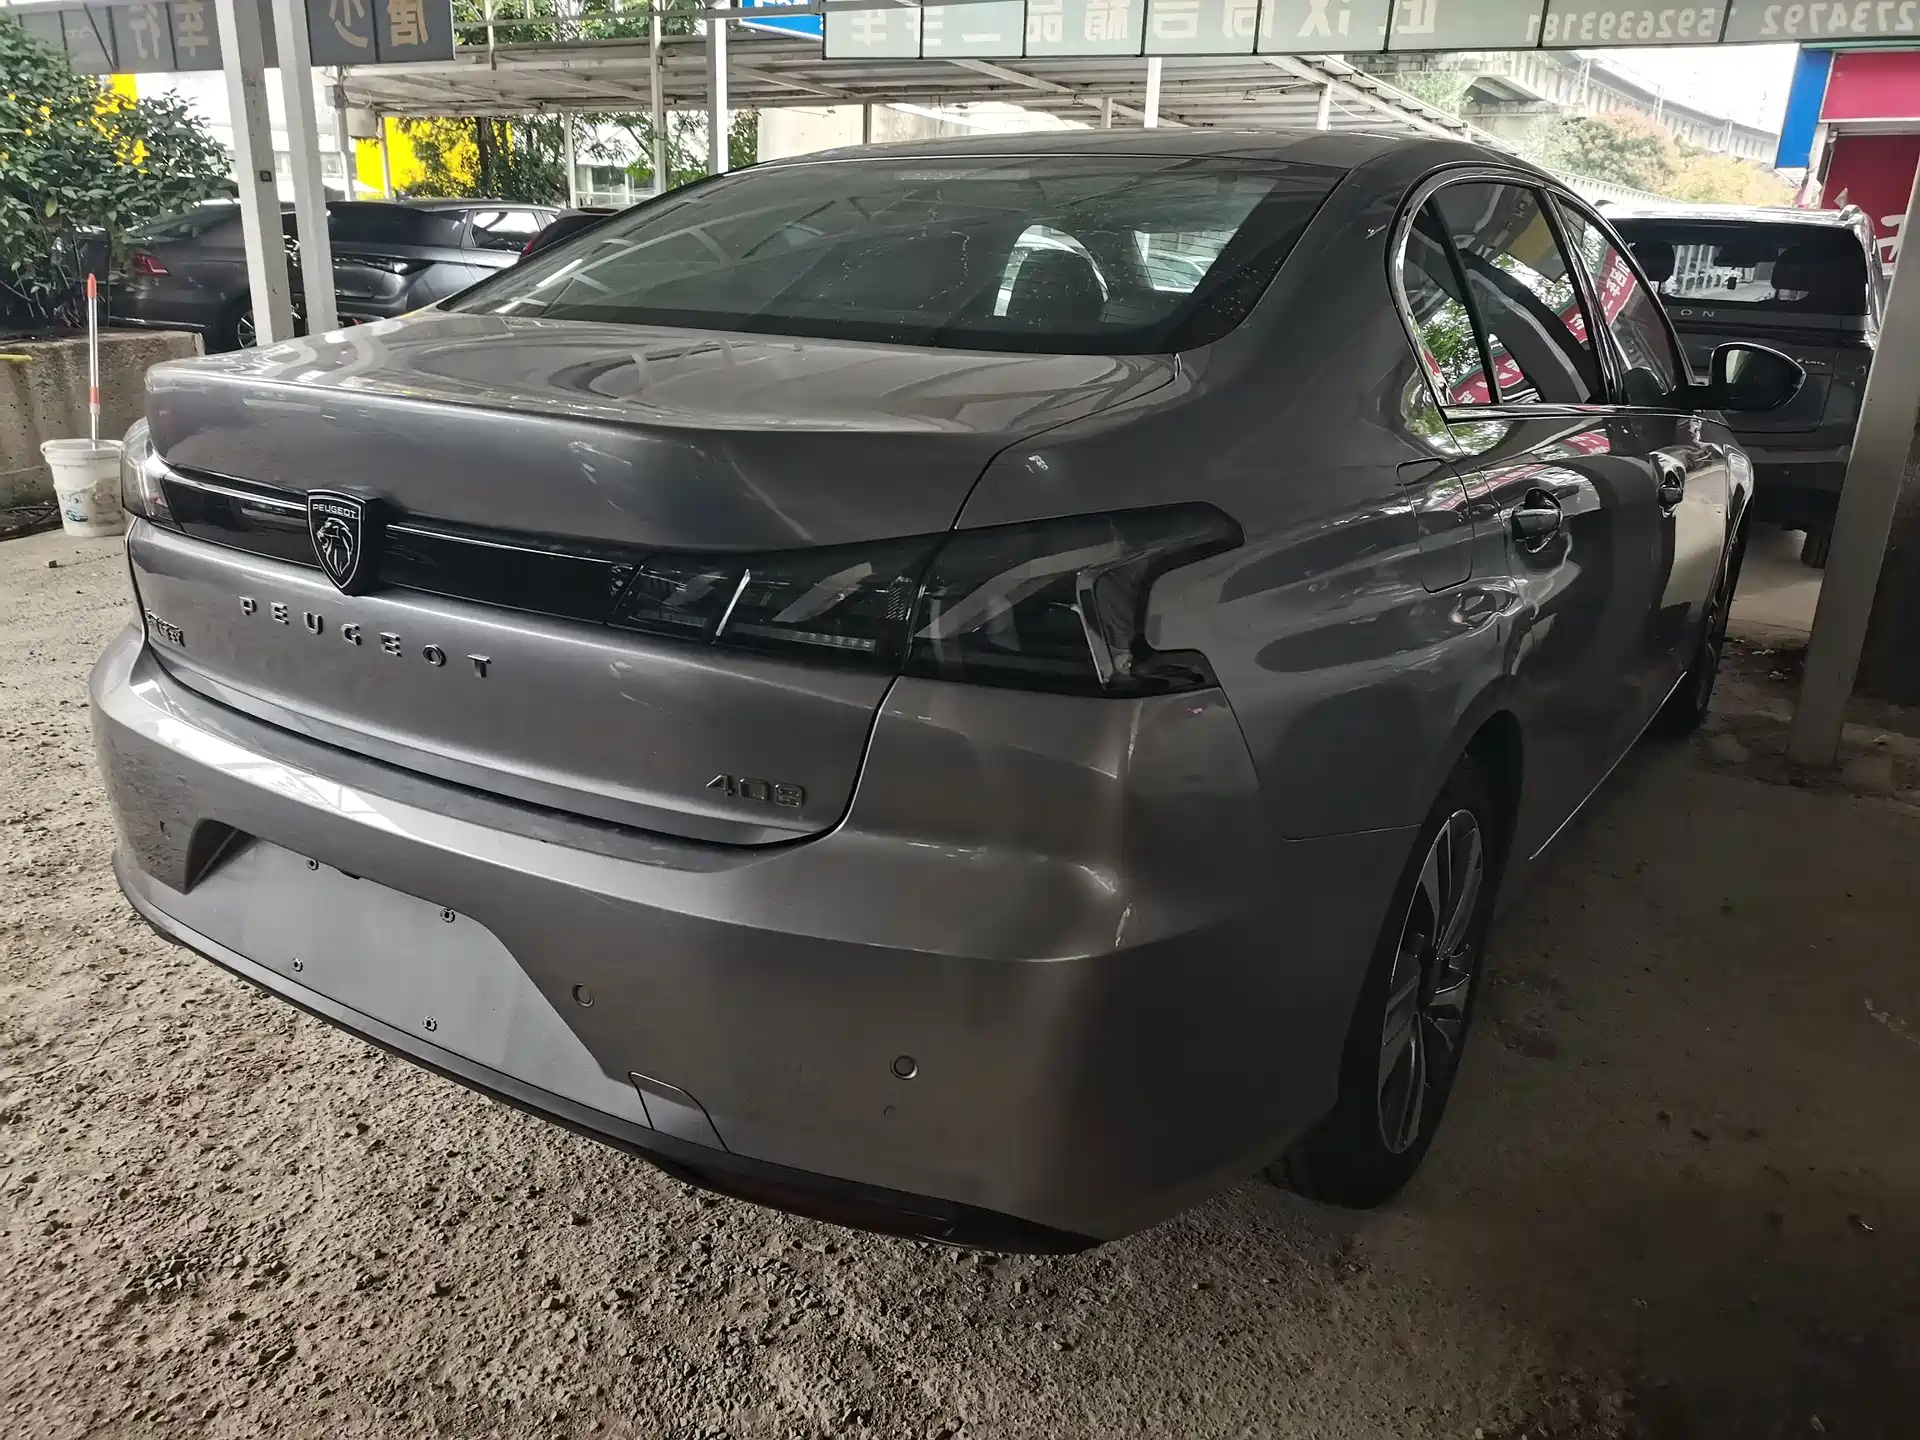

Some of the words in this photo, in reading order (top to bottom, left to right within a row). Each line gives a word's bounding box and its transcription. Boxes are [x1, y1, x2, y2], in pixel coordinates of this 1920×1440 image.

[312, 503, 357, 518] PEUGEOT
[239, 596, 492, 678] PEUGEOT
[706, 774, 804, 808] 408
